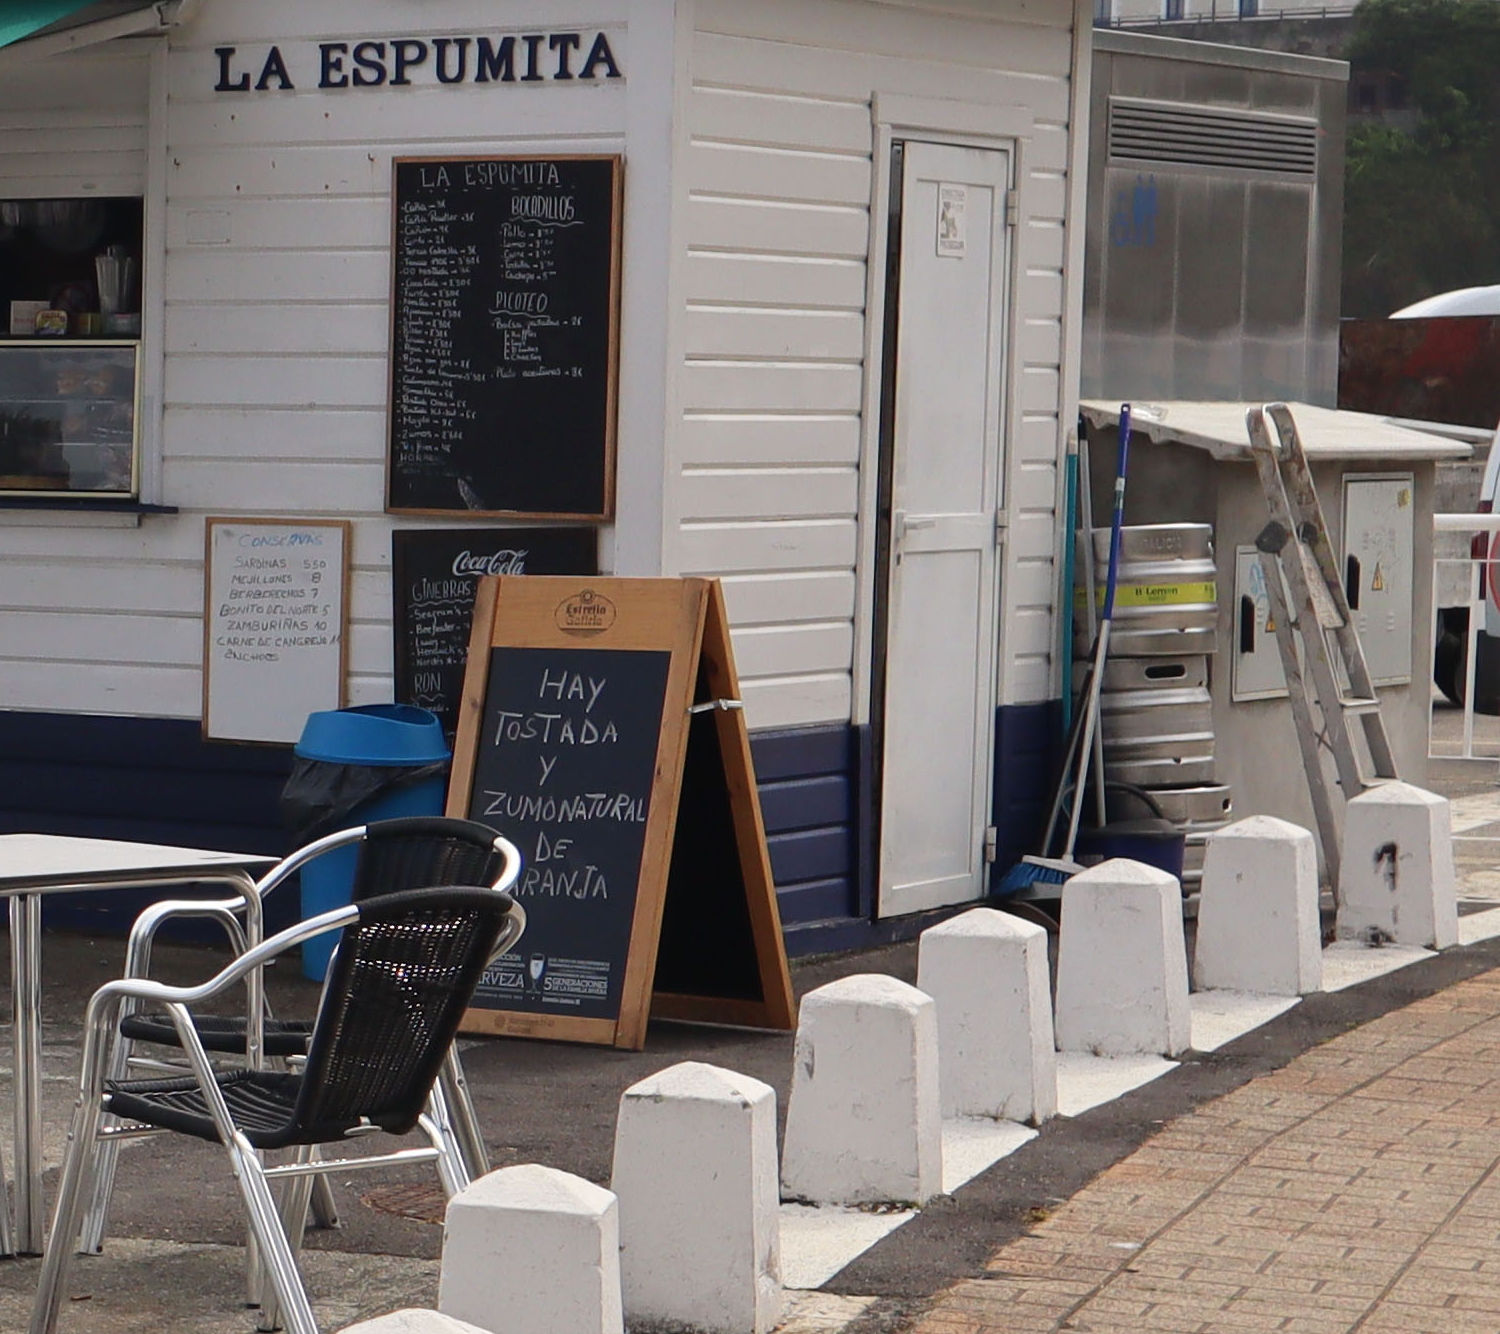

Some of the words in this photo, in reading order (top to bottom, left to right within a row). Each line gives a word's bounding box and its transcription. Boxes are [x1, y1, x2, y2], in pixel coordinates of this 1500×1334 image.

[214, 46, 294, 91] LA
[318, 32, 622, 89] ESPUMITA
[420, 167, 451, 188] LA
[465, 163, 561, 186] ESPUMITA
[511, 195, 575, 220] BOCADILLOS
[496, 291, 548, 313] PICOTEO
[240, 533, 323, 548] CONSERVAS
[235, 556, 287, 569] SARDINAS
[231, 573, 292, 584] MEJILLONES
[311, 572, 321, 583] 8
[229, 588, 305, 600] BERBERECHOS
[311, 588, 319, 598] 7
[220, 604, 264, 617] BONITO
[322, 605, 331, 616] 5
[227, 618, 308, 632] ZAMBURIÑAS
[217, 637, 255, 647] CARNE
[257, 637, 272, 647] DE
[275, 636, 327, 647] CANGREJO
[414, 671, 442, 694] RON
[539, 668, 606, 714] HAY
[495, 710, 619, 747] TOSTADA
[539, 755, 558, 786] Y
[535, 831, 574, 863] DE
[507, 865, 608, 900] ARANJA
[478, 971, 525, 988] RVEZA
[543, 977, 553, 991] 5
